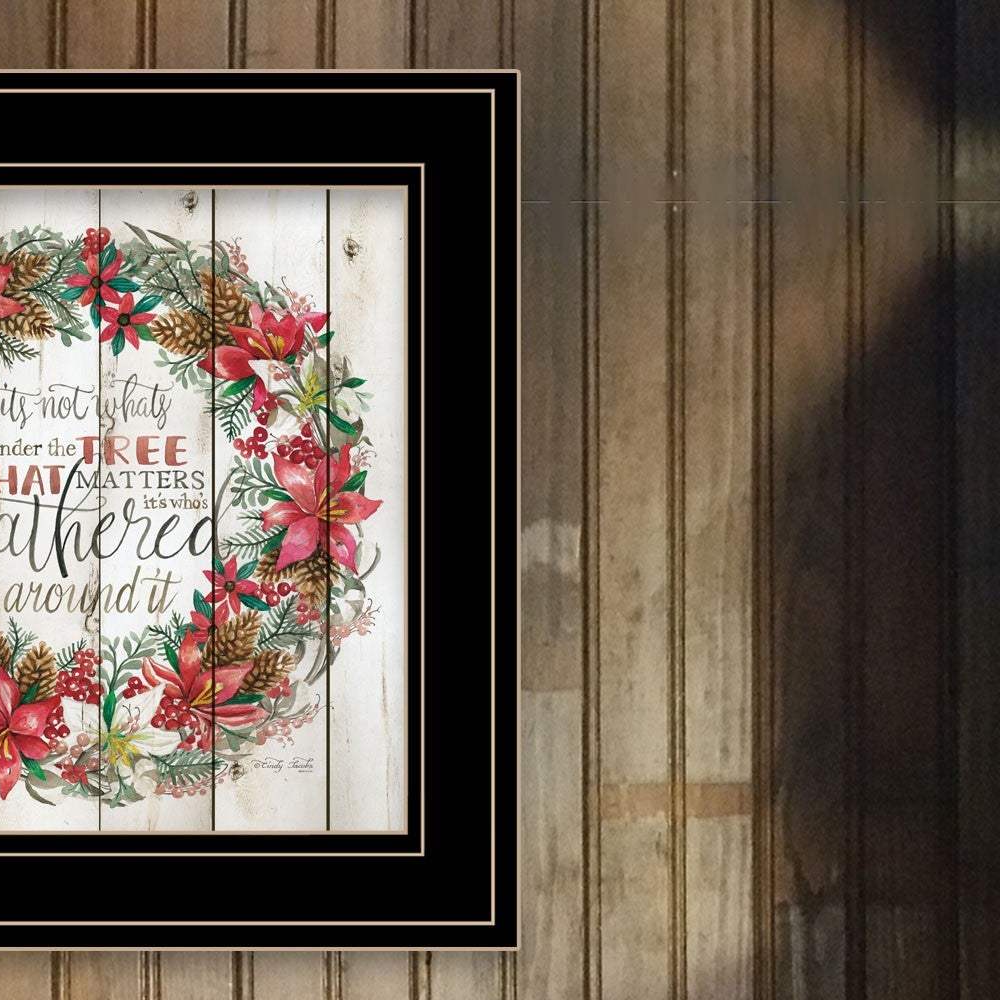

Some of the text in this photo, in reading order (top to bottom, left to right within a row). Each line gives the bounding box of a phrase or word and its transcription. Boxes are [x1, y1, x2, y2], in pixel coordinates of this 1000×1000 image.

[35, 384, 94, 420] not
[48, 438, 76, 457] the
[76, 435, 188, 466] TREE
[76, 470, 205, 490] MATTERS
[143, 492, 208, 511] it's who's
[4, 565, 182, 613] around it
